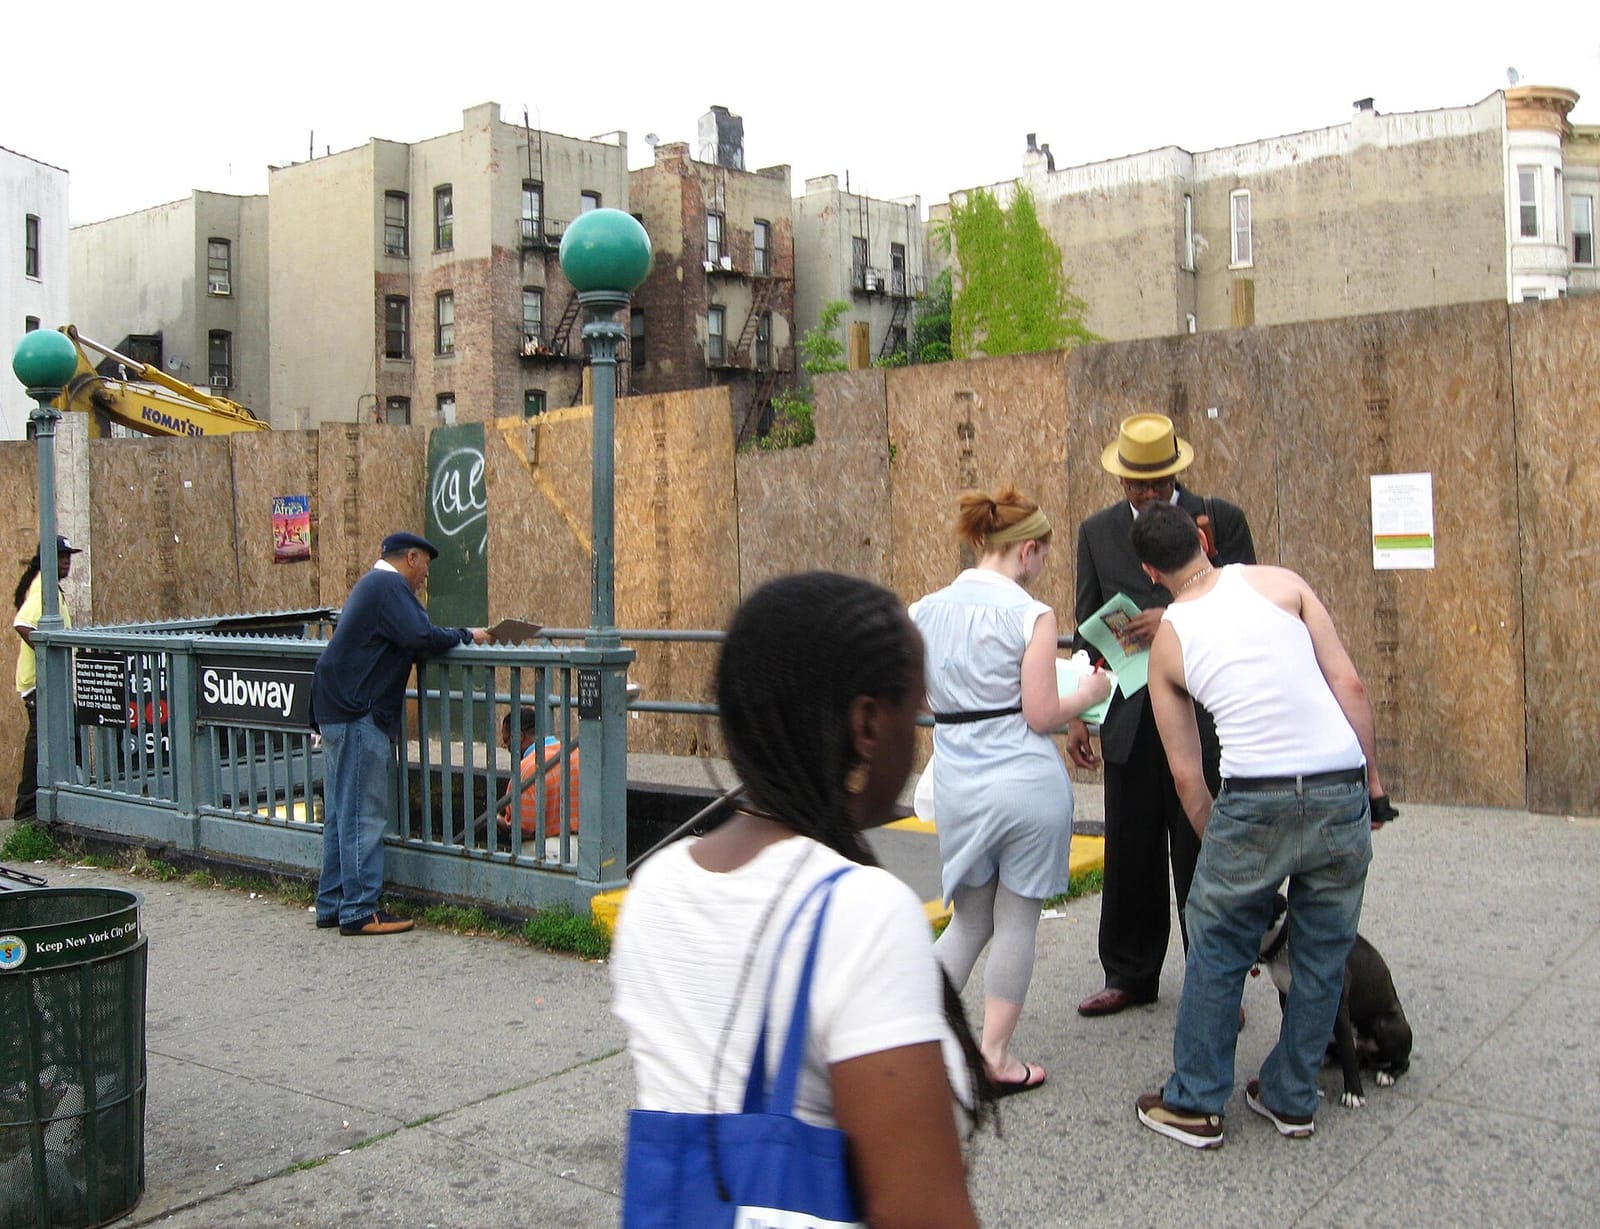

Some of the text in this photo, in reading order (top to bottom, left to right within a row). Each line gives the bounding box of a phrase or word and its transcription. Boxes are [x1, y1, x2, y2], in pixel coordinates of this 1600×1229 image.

[141, 406, 204, 437] KOMATSU
[203, 670, 295, 717] Subway
[36, 943, 63, 953] Keep
[65, 937, 88, 949] New
[88, 931, 110, 944] York
[110, 927, 124, 938] City
